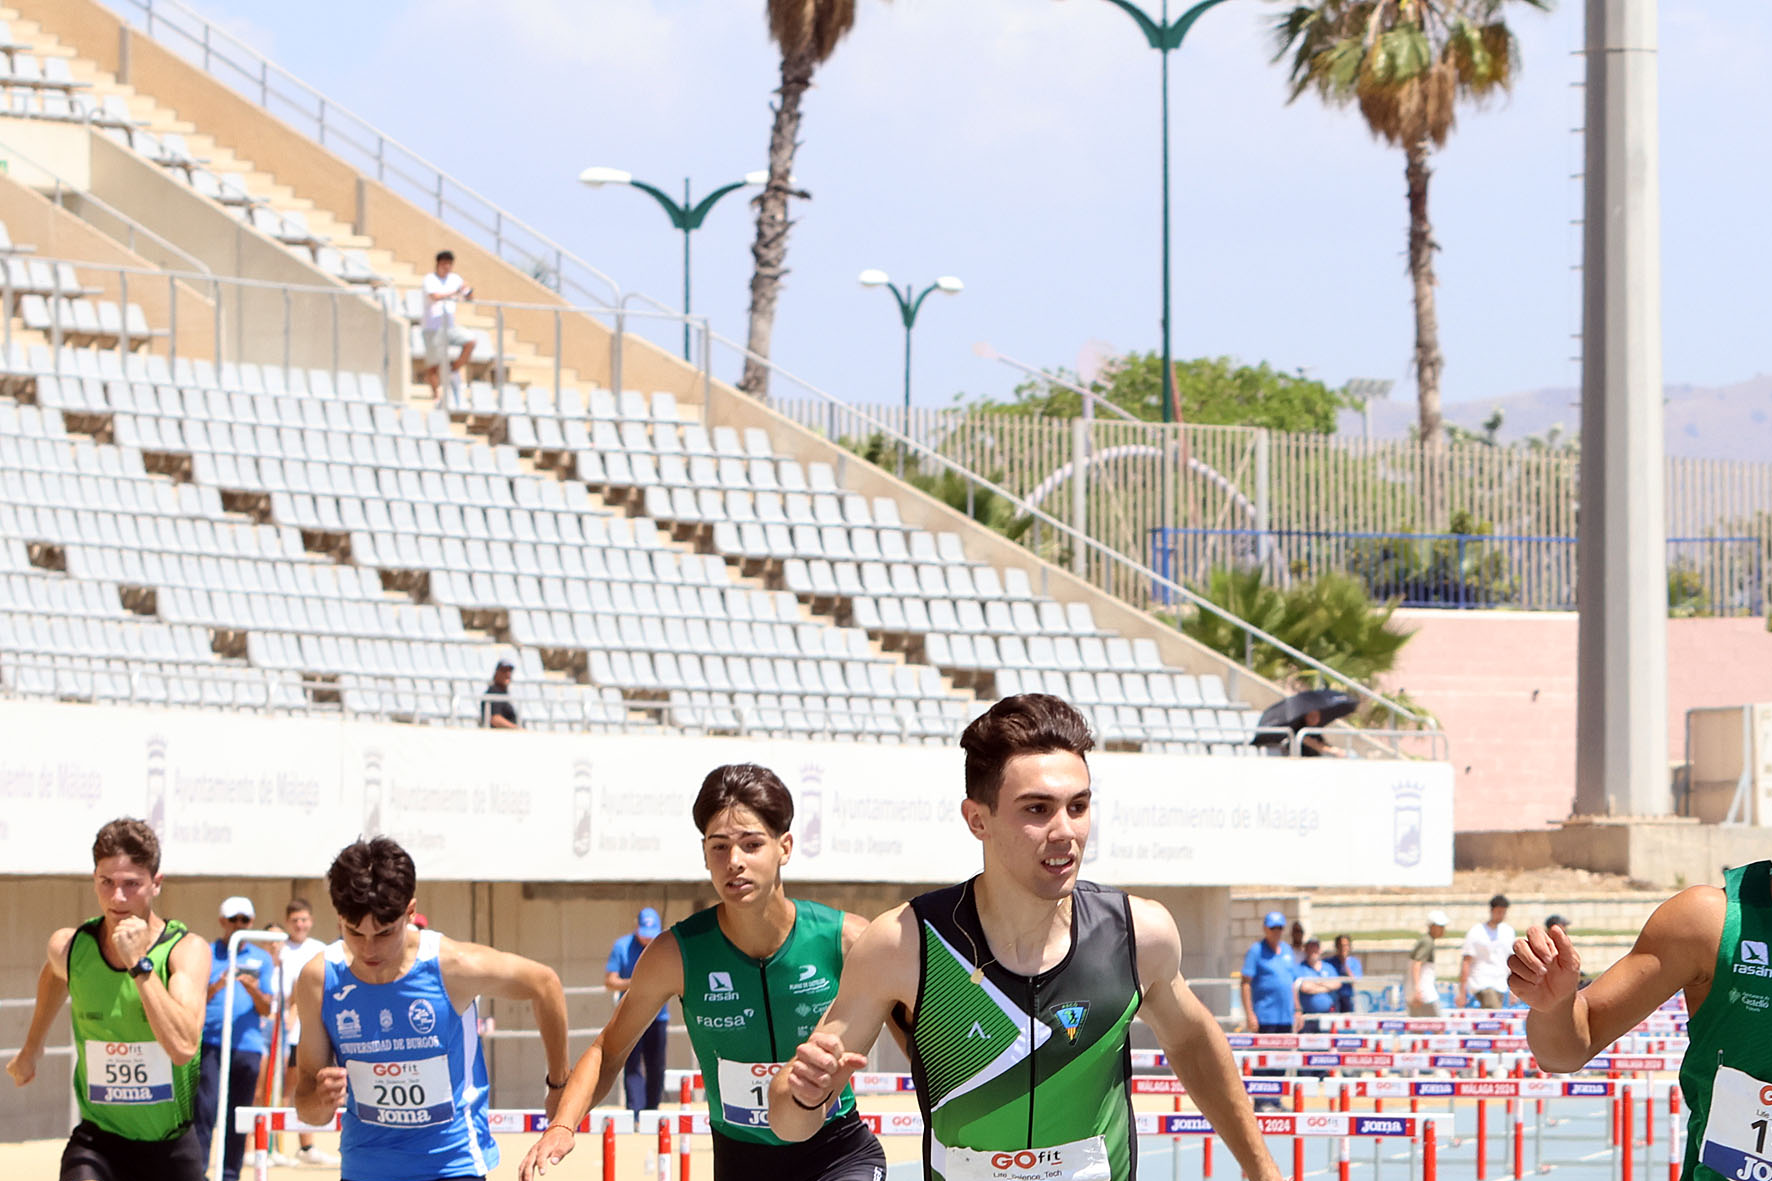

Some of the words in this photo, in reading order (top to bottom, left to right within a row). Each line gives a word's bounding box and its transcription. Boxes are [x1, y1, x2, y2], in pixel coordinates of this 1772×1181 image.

[1111, 800, 1225, 835] Ayuntamiento
[1231, 803, 1252, 829] de
[340, 1038, 392, 1054] UNIVERSIDAD
[393, 1039, 405, 1050] DE
[406, 1035, 440, 1049] BURGOS
[105, 1063, 149, 1084] 596
[104, 1087, 153, 1101] Joma
[373, 1084, 426, 1106] 200
[377, 1109, 431, 1123] Joma
[1265, 1119, 1291, 1132] 2024
[1361, 1119, 1402, 1134] Joma
[991, 1150, 1063, 1170] GOfit
